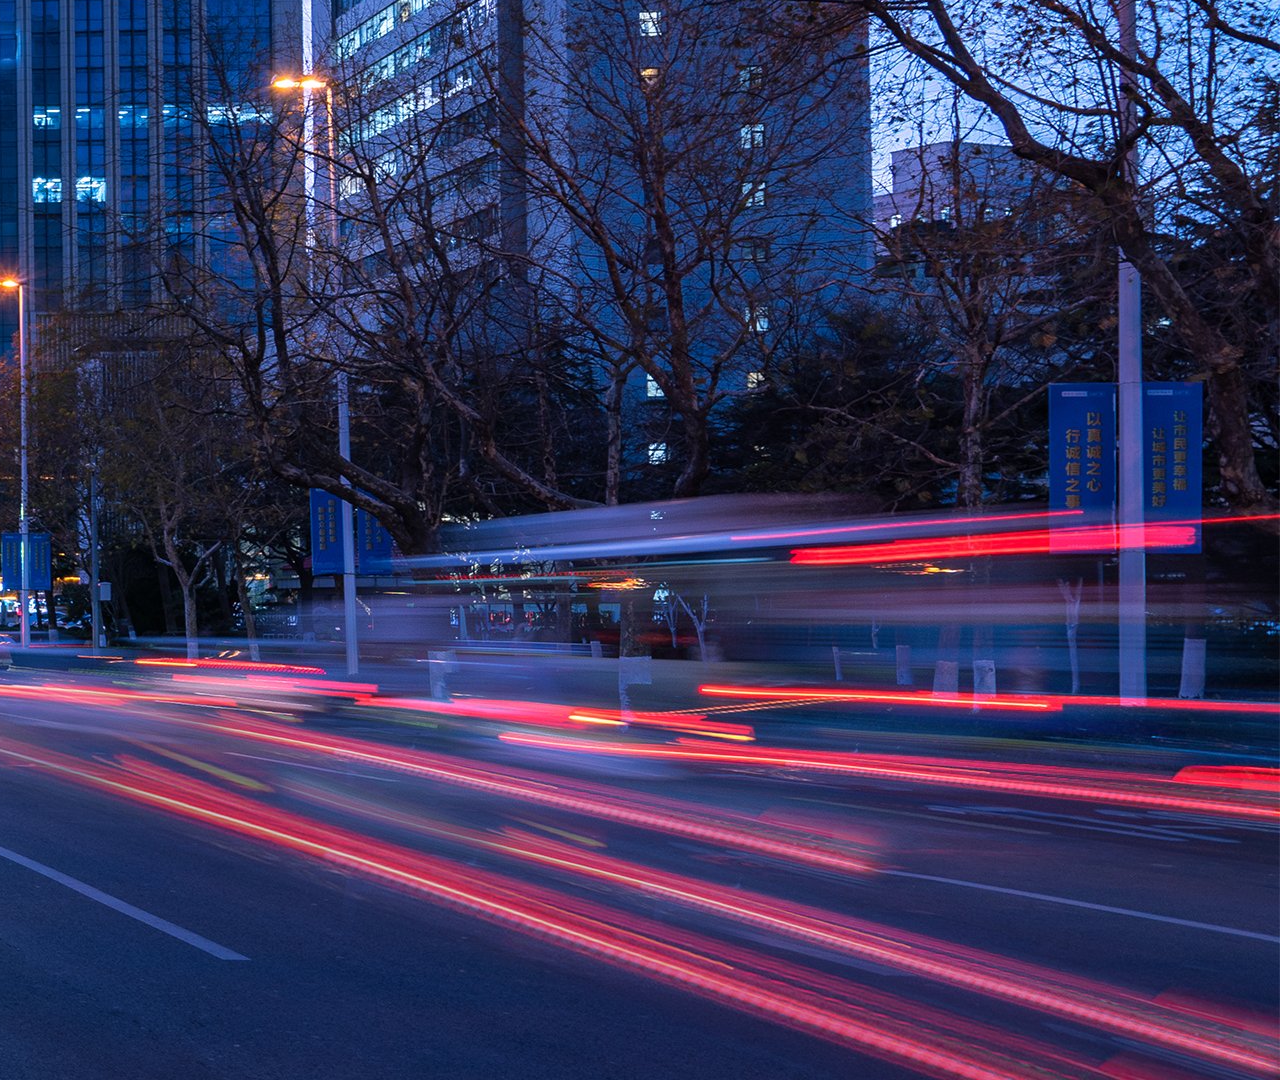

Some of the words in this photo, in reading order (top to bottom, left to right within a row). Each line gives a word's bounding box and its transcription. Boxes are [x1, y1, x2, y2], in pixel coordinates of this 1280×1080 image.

[1065, 428, 1081, 509] 行诚信之事
[1086, 411, 1102, 493] 以真诚之心
[1151, 427, 1167, 508] 让城市更美好
[1172, 410, 1187, 491] 让市民更幸福
